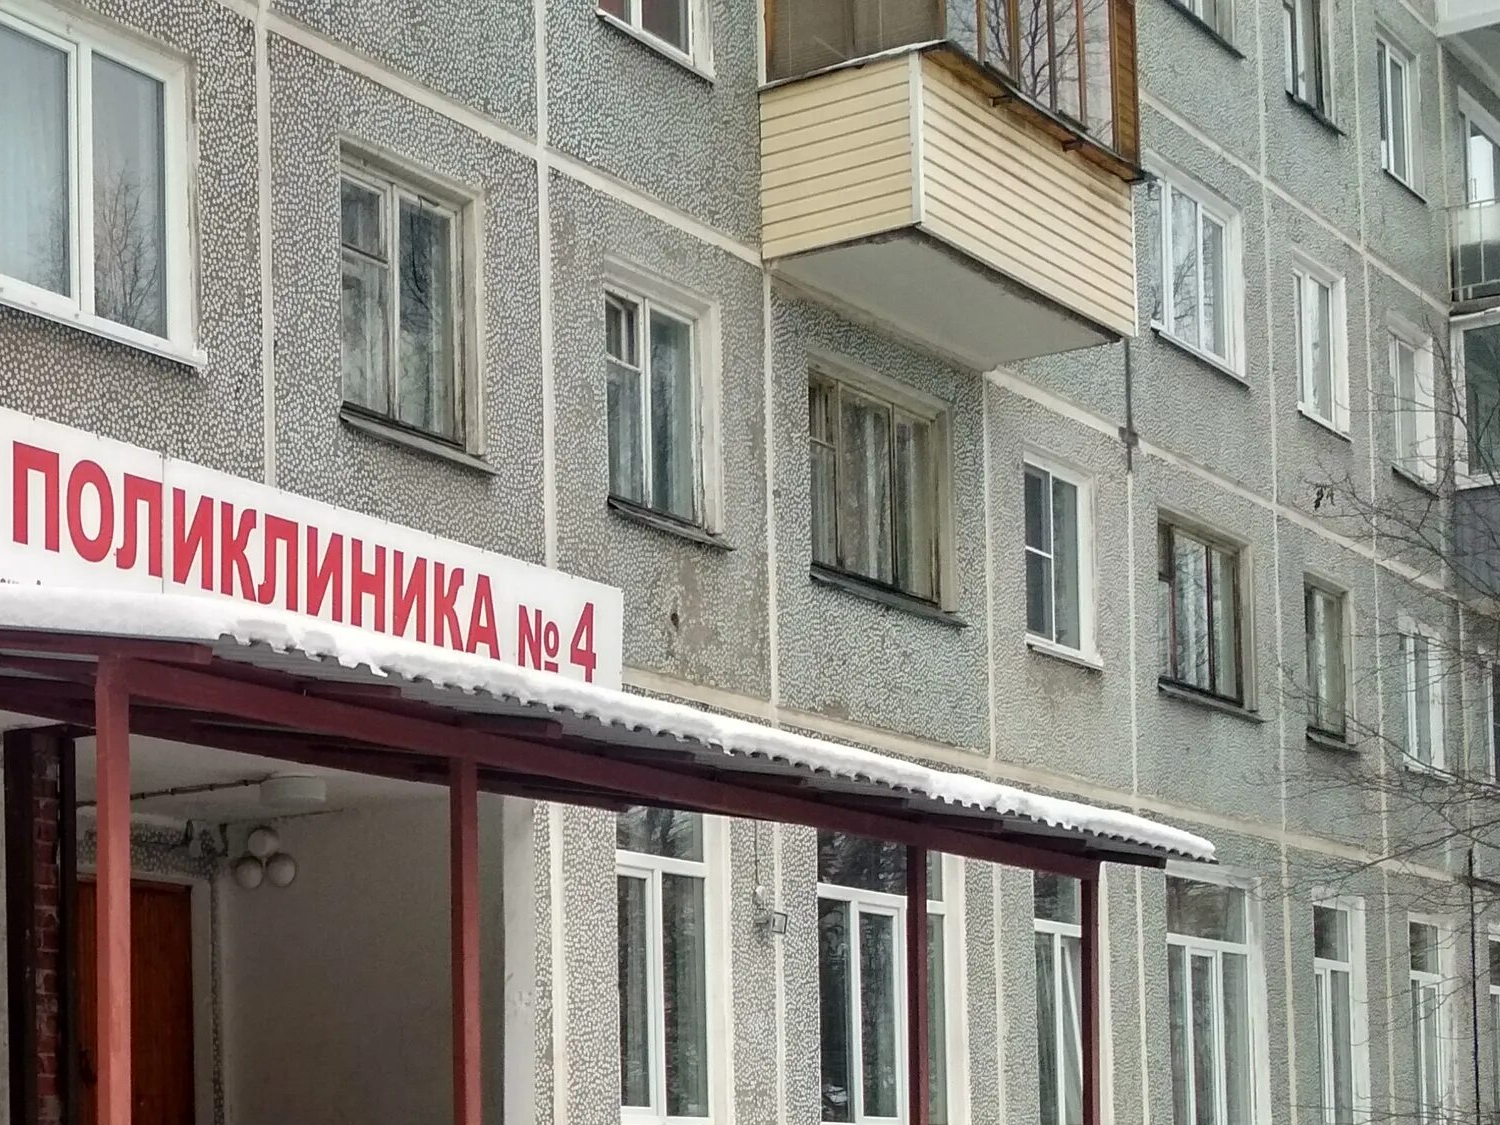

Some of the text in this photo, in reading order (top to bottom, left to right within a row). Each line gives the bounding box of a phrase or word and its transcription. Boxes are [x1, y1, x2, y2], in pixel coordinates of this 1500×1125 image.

[12, 441, 501, 661] ПОЛИКЛИНИКА
[518, 604, 560, 673] №
[570, 601, 597, 684] 4
